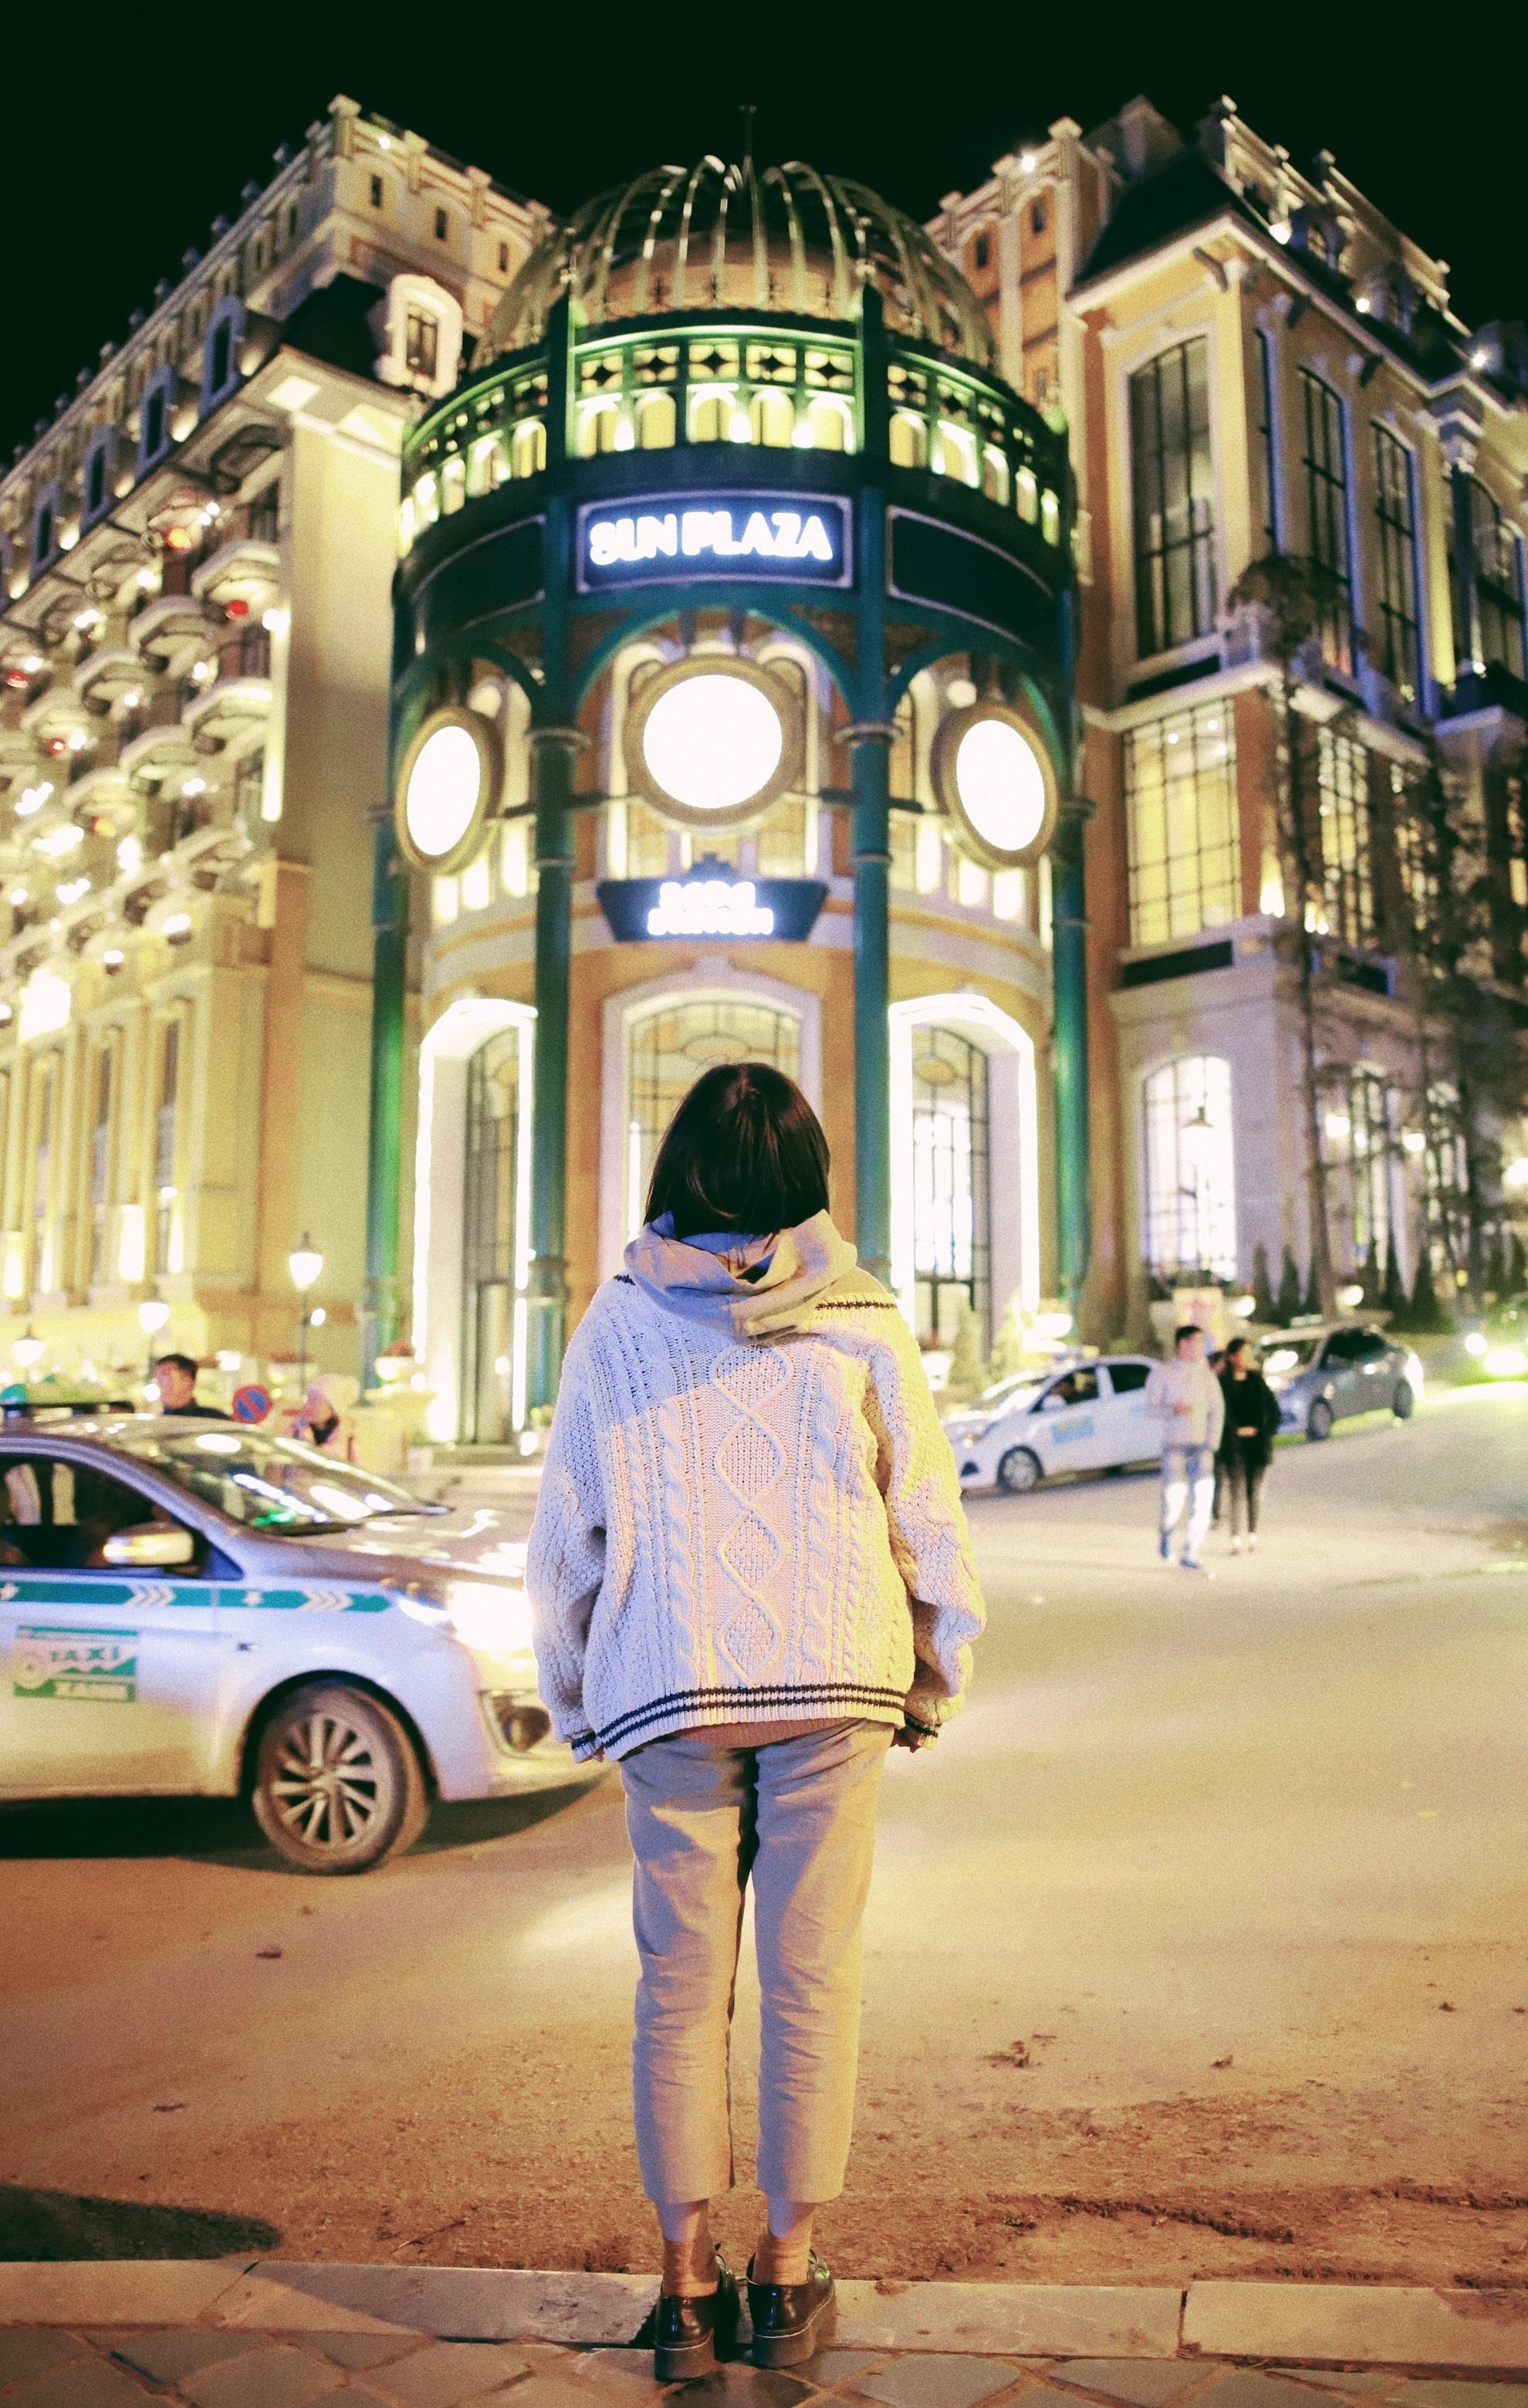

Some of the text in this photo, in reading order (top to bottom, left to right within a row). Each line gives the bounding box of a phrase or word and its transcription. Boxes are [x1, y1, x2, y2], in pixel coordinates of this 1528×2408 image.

[590, 511, 833, 565] SUN PLAZA
[50, 1645, 120, 1662] TAXI
